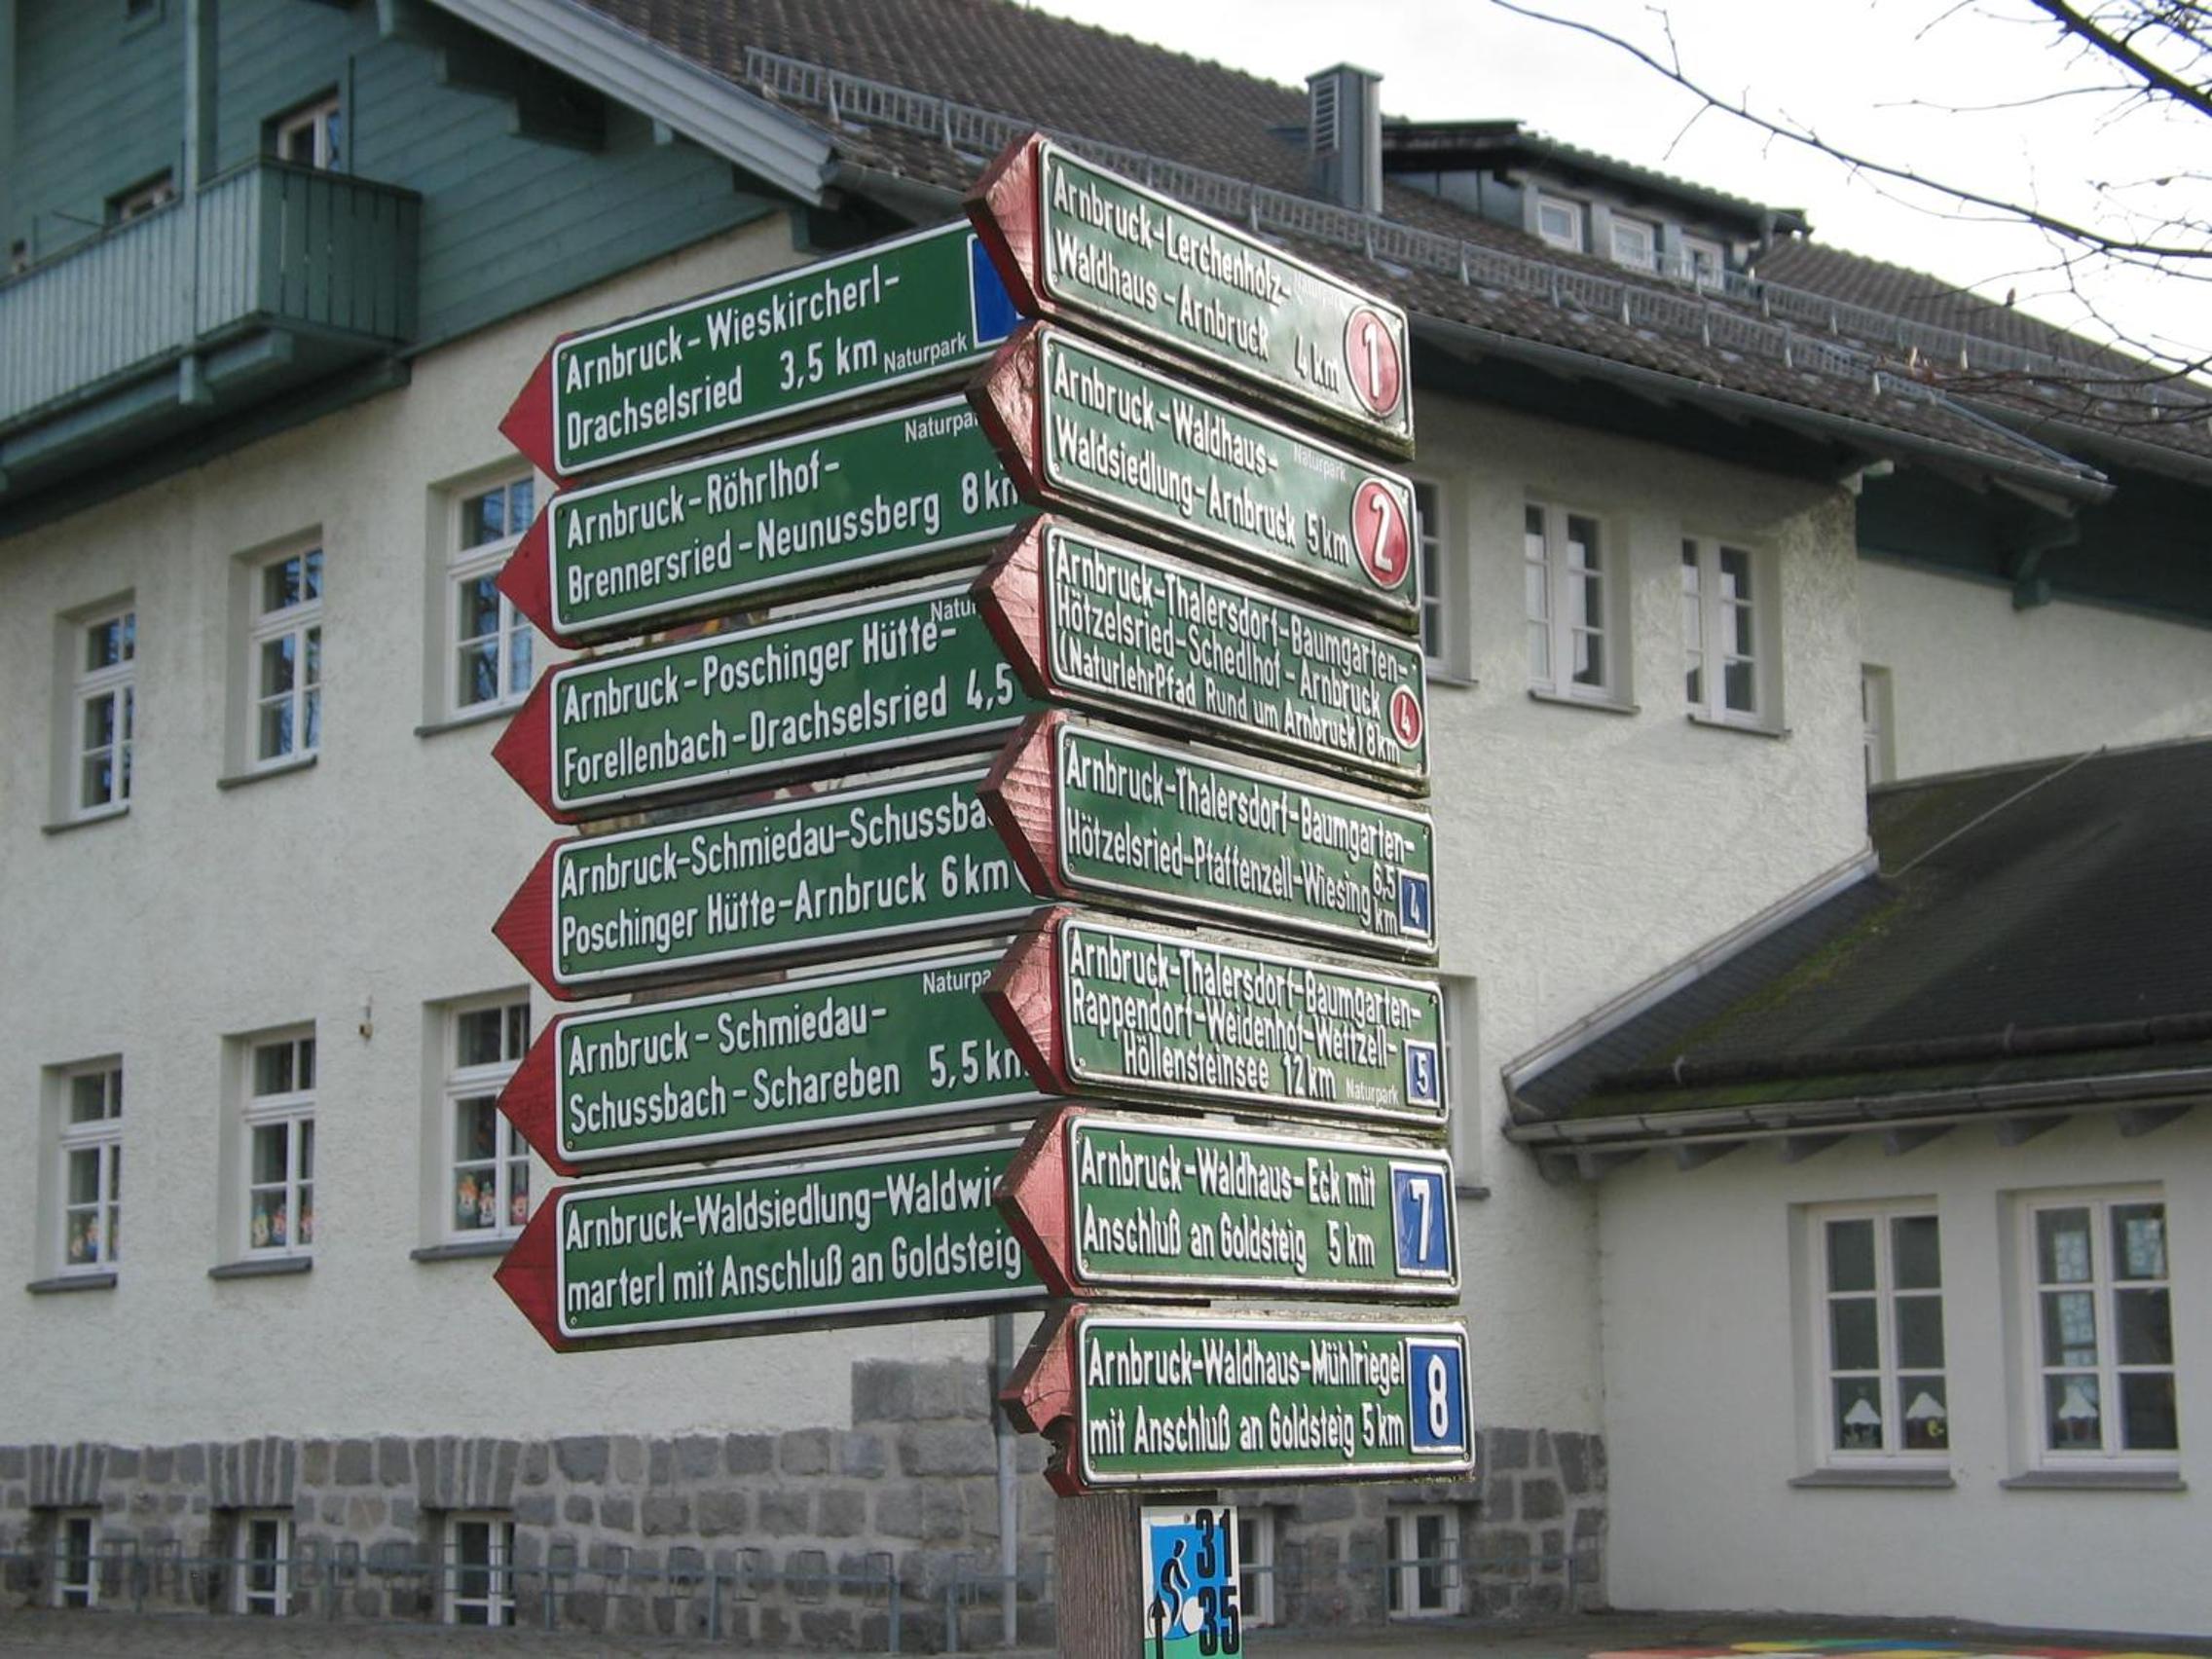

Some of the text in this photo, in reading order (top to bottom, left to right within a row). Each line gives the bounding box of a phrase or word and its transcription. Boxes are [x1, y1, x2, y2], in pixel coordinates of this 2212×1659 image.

[1055, 230, 1157, 313] Waldhaus
[1364, 322, 1379, 397] 1
[568, 334, 968, 451] Drachselsried 3,5 km Naturpark
[905, 412, 978, 443] Naturpa
[1294, 444, 1346, 481] Naturpark
[962, 471, 978, 514] 8
[1373, 493, 1392, 571] 2
[931, 598, 977, 622] Natur
[967, 662, 1013, 711] 4,5
[1205, 677, 1246, 721] Rund
[1254, 699, 1277, 730] um
[1400, 694, 1411, 733] 4
[562, 904, 699, 957] Poschinger
[941, 854, 958, 898] 6
[965, 853, 1009, 895] km
[1372, 864, 1395, 903] 6,5
[1410, 884, 1420, 925] 4
[1373, 898, 1397, 935] km
[923, 970, 991, 994] Naturp
[1123, 1028, 1269, 1089] Höllensteinsee
[1346, 1080, 1398, 1106] Naturpark
[1415, 1052, 1428, 1095] 5
[1346, 1165, 1375, 1207] mit
[1083, 1203, 1375, 1273] Anschluß an Goldsteig 5 km
[1410, 1180, 1430, 1262] 7
[568, 1229, 1020, 1312] marterl mit Anschluß an Goldsteig
[1428, 1355, 1448, 1438] 8
[1089, 1408, 1124, 1455] mit
[1134, 1403, 1230, 1453] Anschluß
[1240, 1414, 1263, 1451] an
[1270, 1403, 1354, 1457] Goldsteig
[1196, 1508, 1233, 1578] 31
[1198, 1585, 1239, 1655] 35
